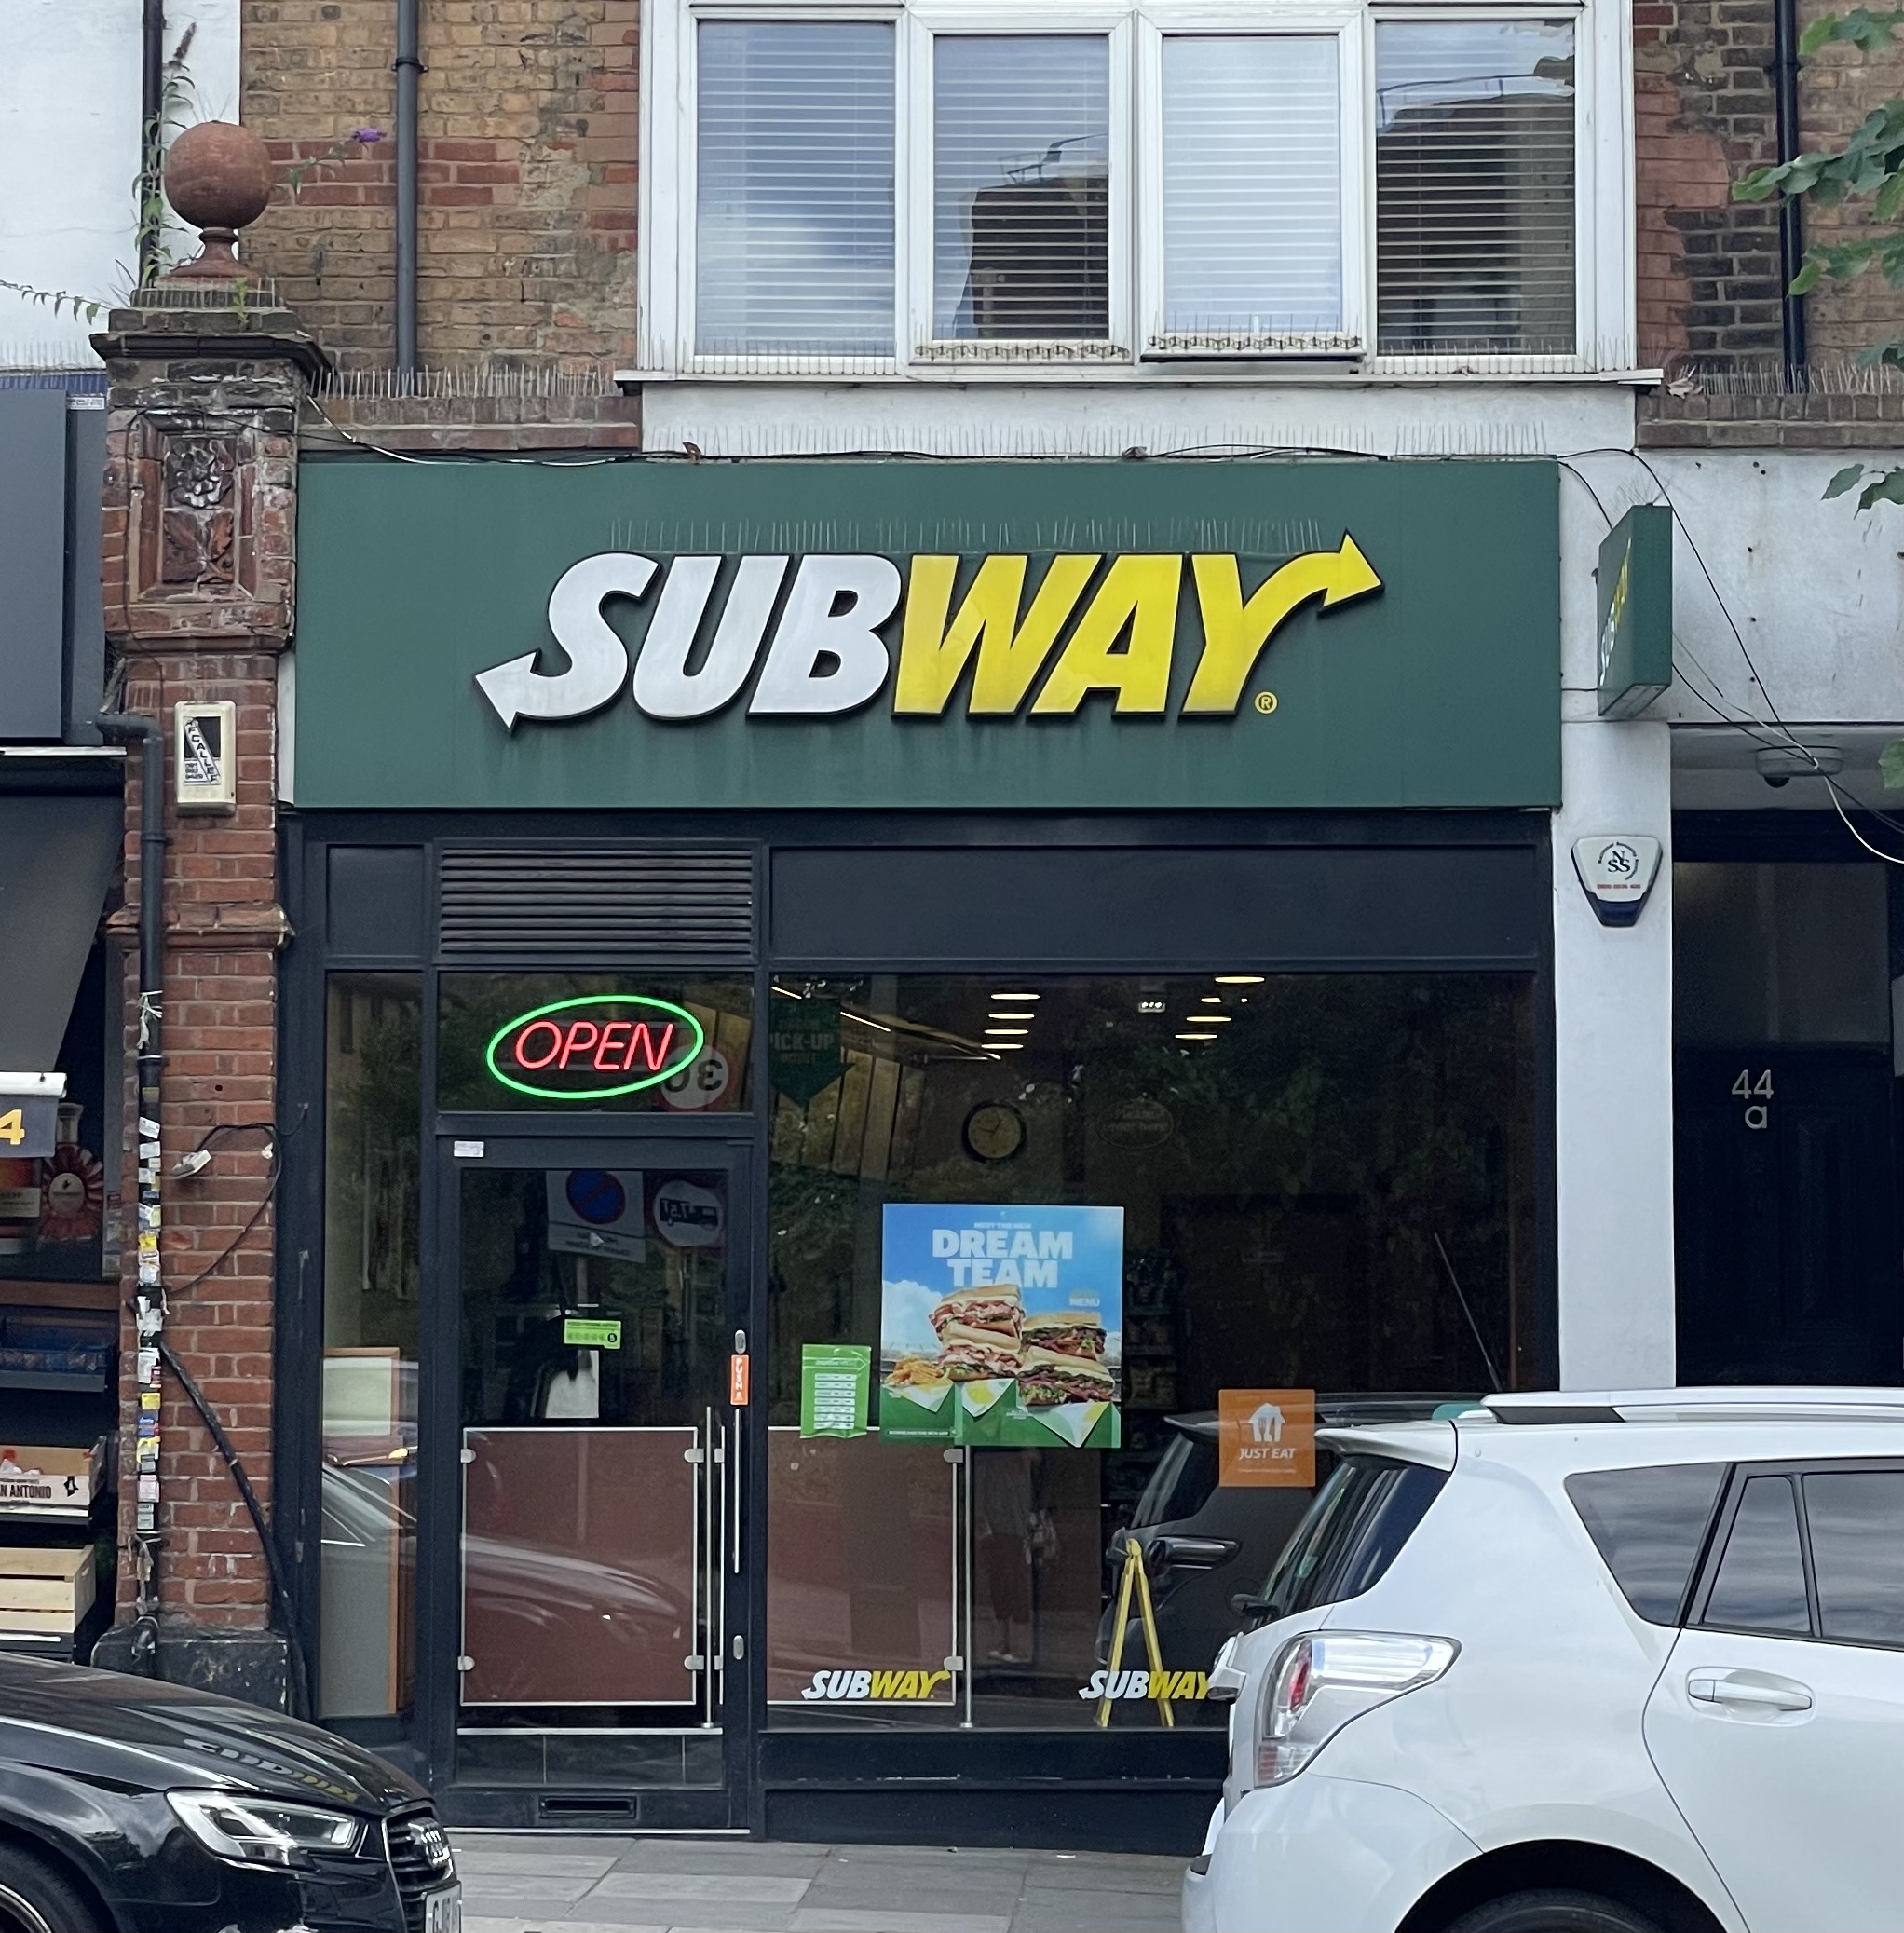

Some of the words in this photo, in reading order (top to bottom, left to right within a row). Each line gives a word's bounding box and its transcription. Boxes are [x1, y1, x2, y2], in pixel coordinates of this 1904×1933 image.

[475, 531, 1383, 729] SUBWAY
[515, 1020, 673, 1071] OPEN
[1732, 1069, 1774, 1099] 44
[0, 1109, 25, 1145] 4
[1745, 1106, 1767, 1129] a
[932, 1229, 1073, 1259] DREAM
[947, 1259, 1058, 1288] TEAM
[1239, 1448, 1269, 1461] JUST
[1272, 1448, 1296, 1459] EAT
[10, 1485, 51, 1499] ANTONIO
[801, 1669, 952, 1700] SUBWAY
[1079, 1669, 1210, 1700] SUBWAY
